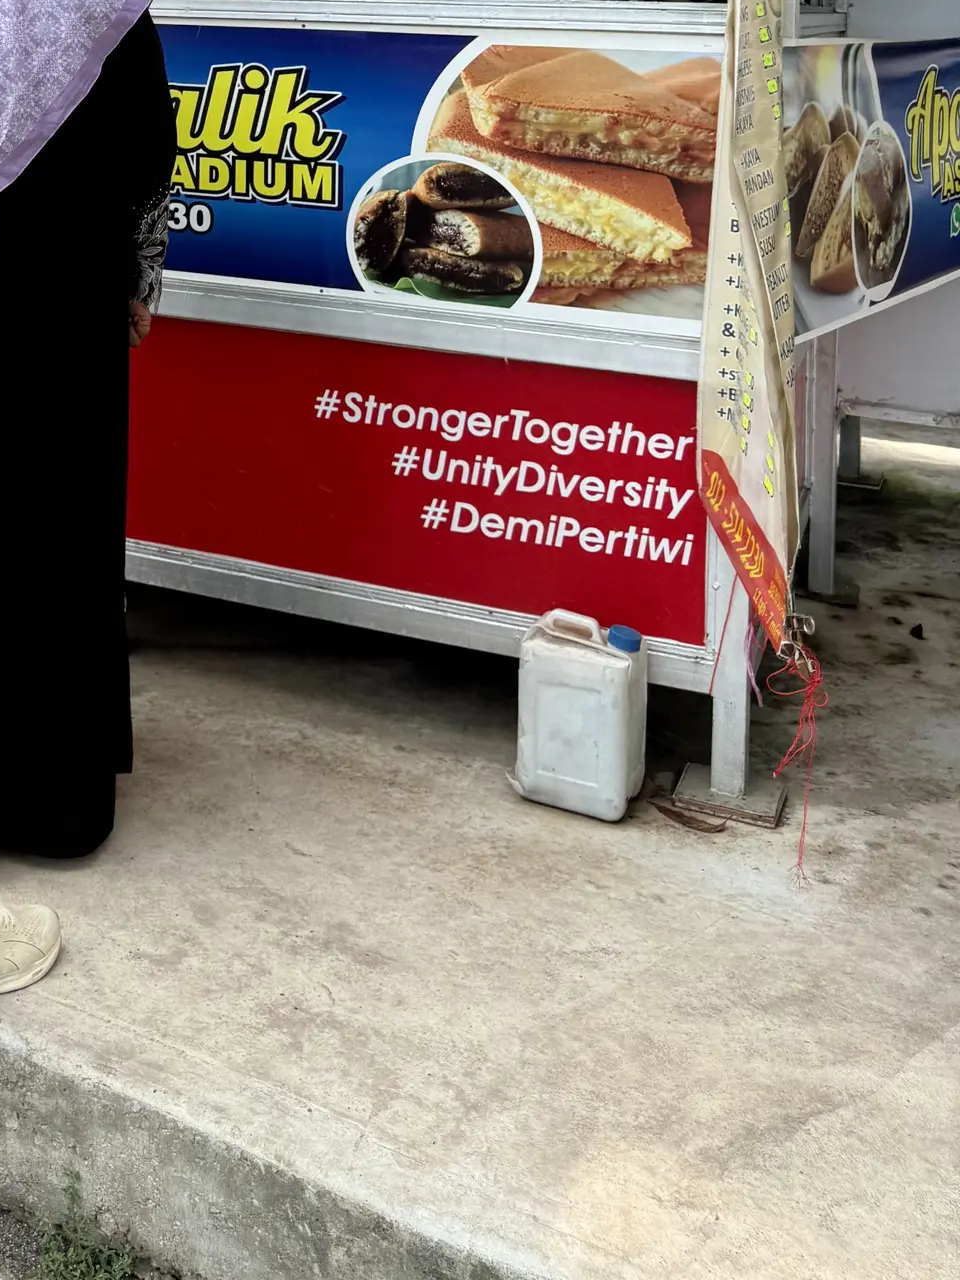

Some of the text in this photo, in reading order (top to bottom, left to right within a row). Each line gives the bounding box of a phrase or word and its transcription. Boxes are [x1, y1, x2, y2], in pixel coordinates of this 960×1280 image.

[169, 66, 341, 161] alik
[169, 154, 337, 204] ADIUM
[744, 169, 774, 196] PANDAN
[168, 203, 213, 233] 30
[759, 233, 776, 258] SUSU
[773, 293, 791, 320] UTTER
[722, 323, 735, 338] &
[314, 389, 693, 461] #StrongerTogether
[391, 446, 694, 519] #UnityDiversity
[420, 498, 694, 566] #DemiPertiwi
